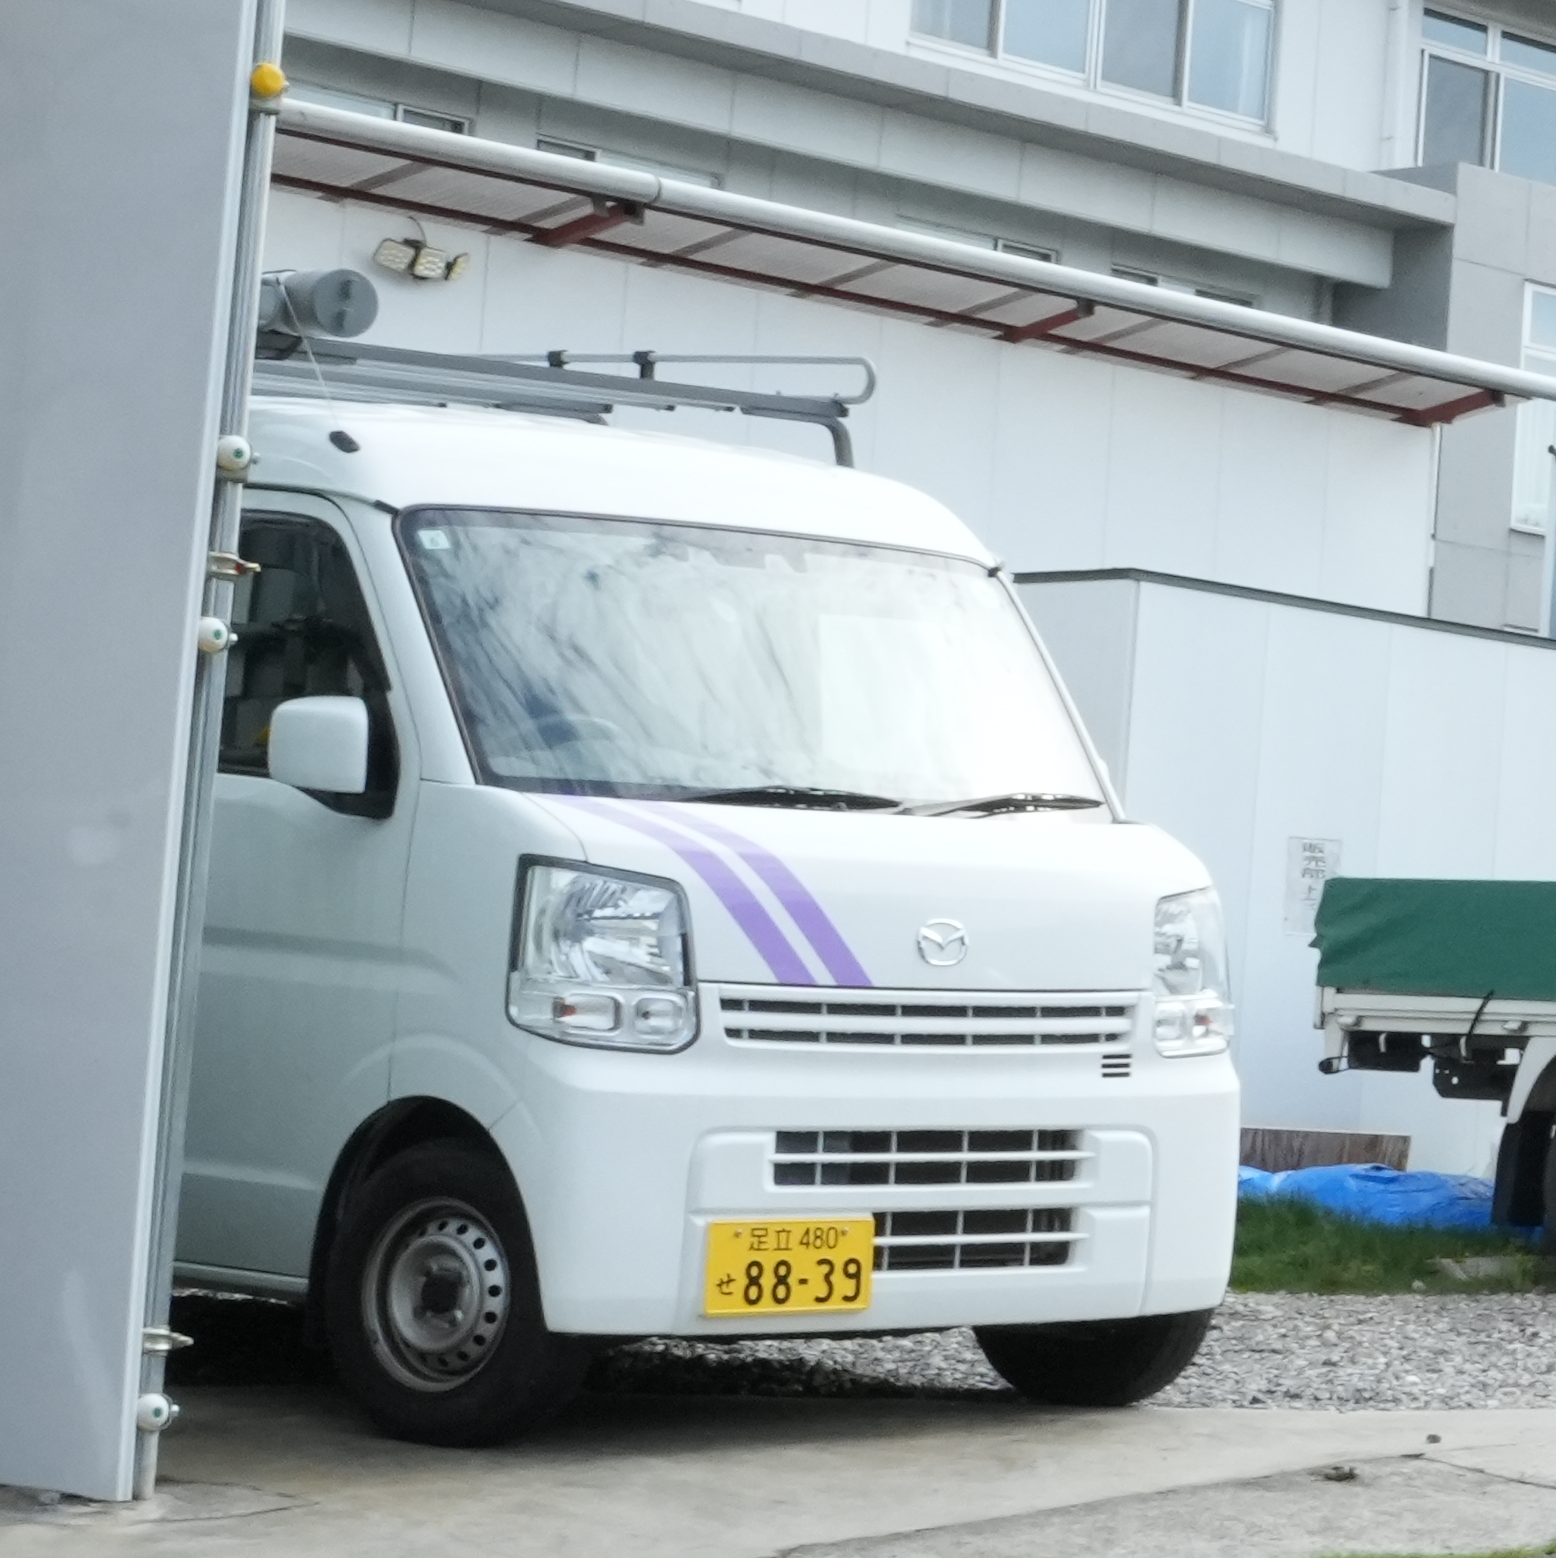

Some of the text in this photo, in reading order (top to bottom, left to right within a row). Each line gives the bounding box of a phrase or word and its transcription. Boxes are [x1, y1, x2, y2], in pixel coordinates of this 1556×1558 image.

[748, 1226, 838, 1251] 足立 480
[716, 1258, 862, 1305] せ 88-39
